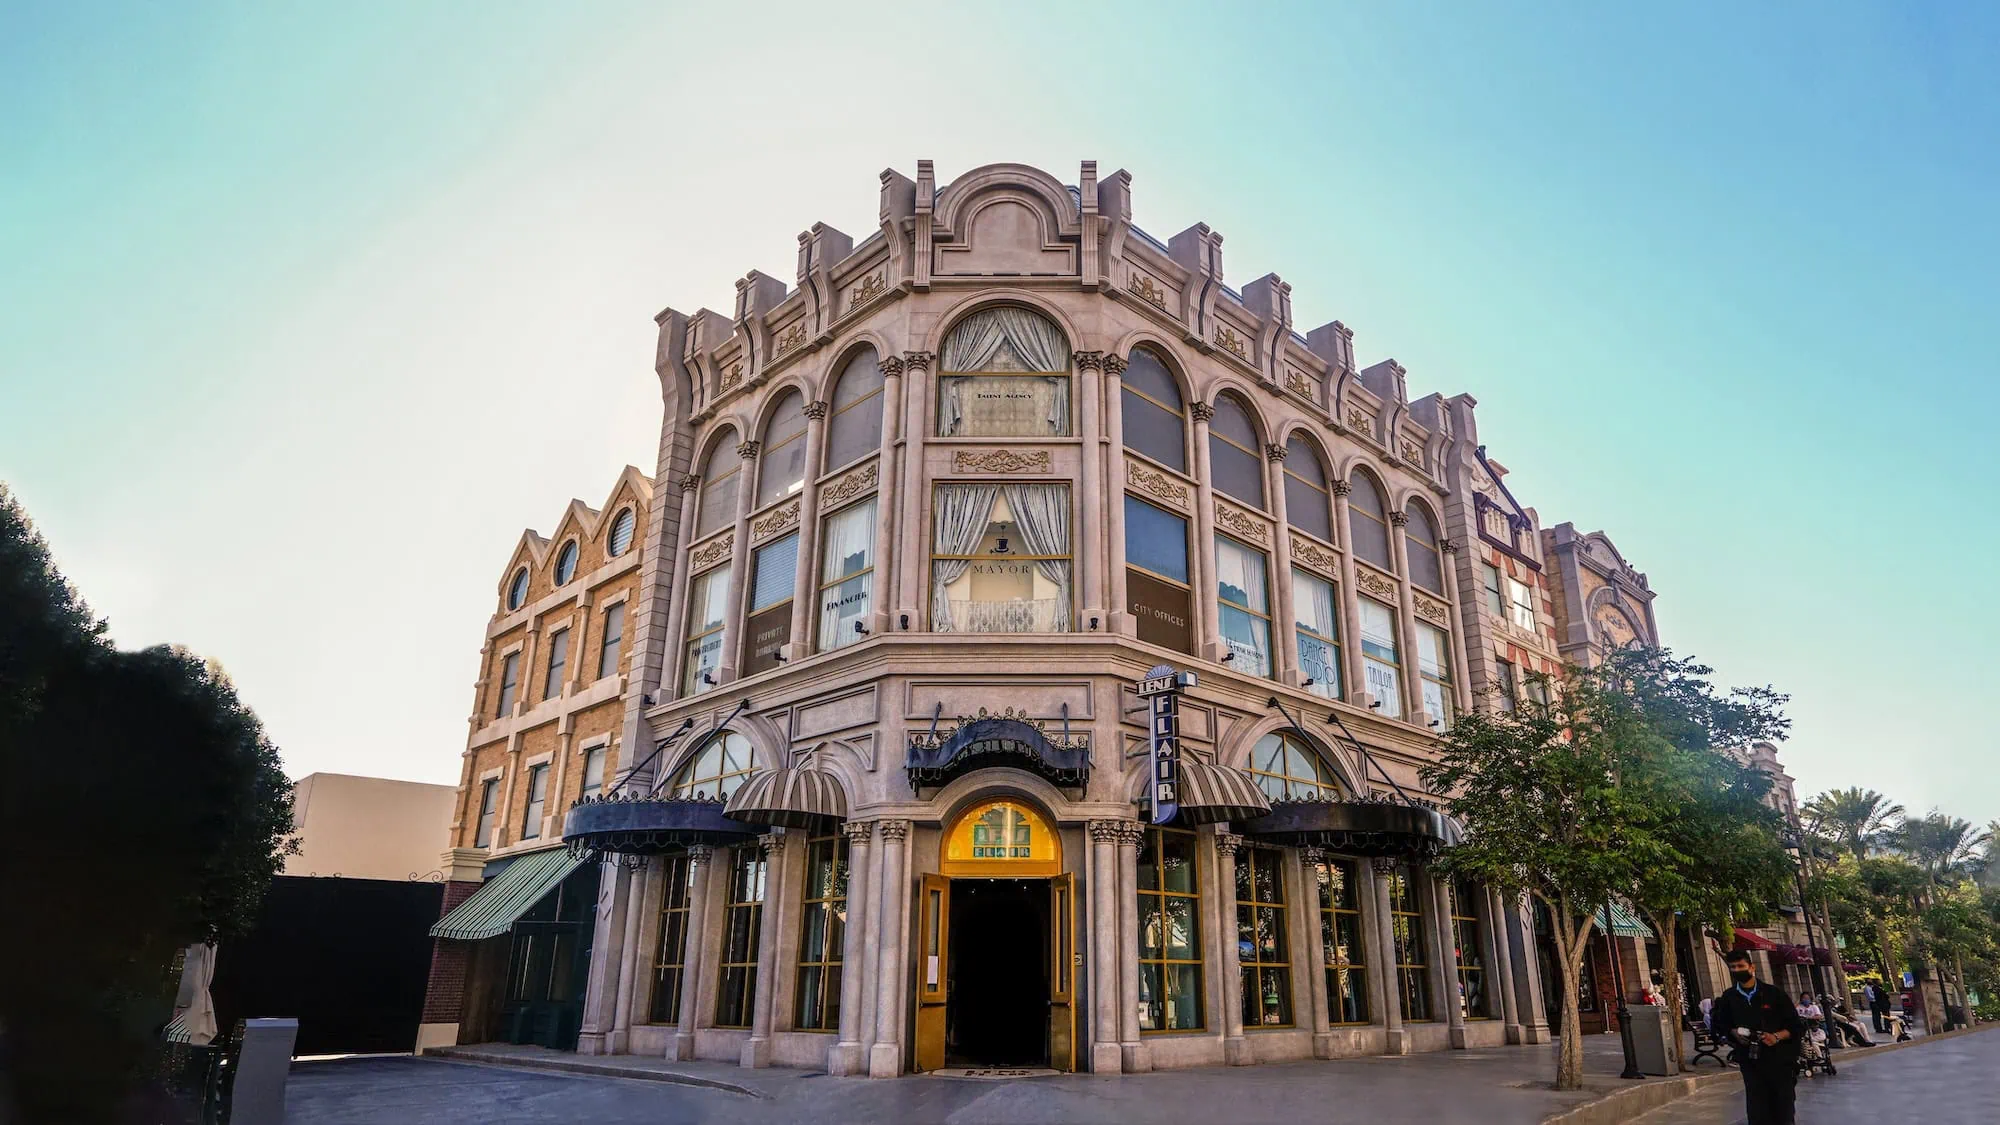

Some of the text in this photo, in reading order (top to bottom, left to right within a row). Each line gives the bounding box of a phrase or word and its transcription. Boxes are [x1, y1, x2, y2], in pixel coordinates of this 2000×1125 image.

[973, 565, 1029, 574] MAYOR
[826, 591, 867, 611] FINANCIER
[1134, 603, 1184, 627] CITY OFFICES
[1301, 639, 1328, 666] DANCE
[1303, 657, 1336, 685] STUDIO
[1367, 666, 1395, 690] TAILOR
[1138, 677, 1173, 694] LENS
[1156, 695, 1174, 801] FLAIR
[974, 847, 1029, 857] FLAIR
